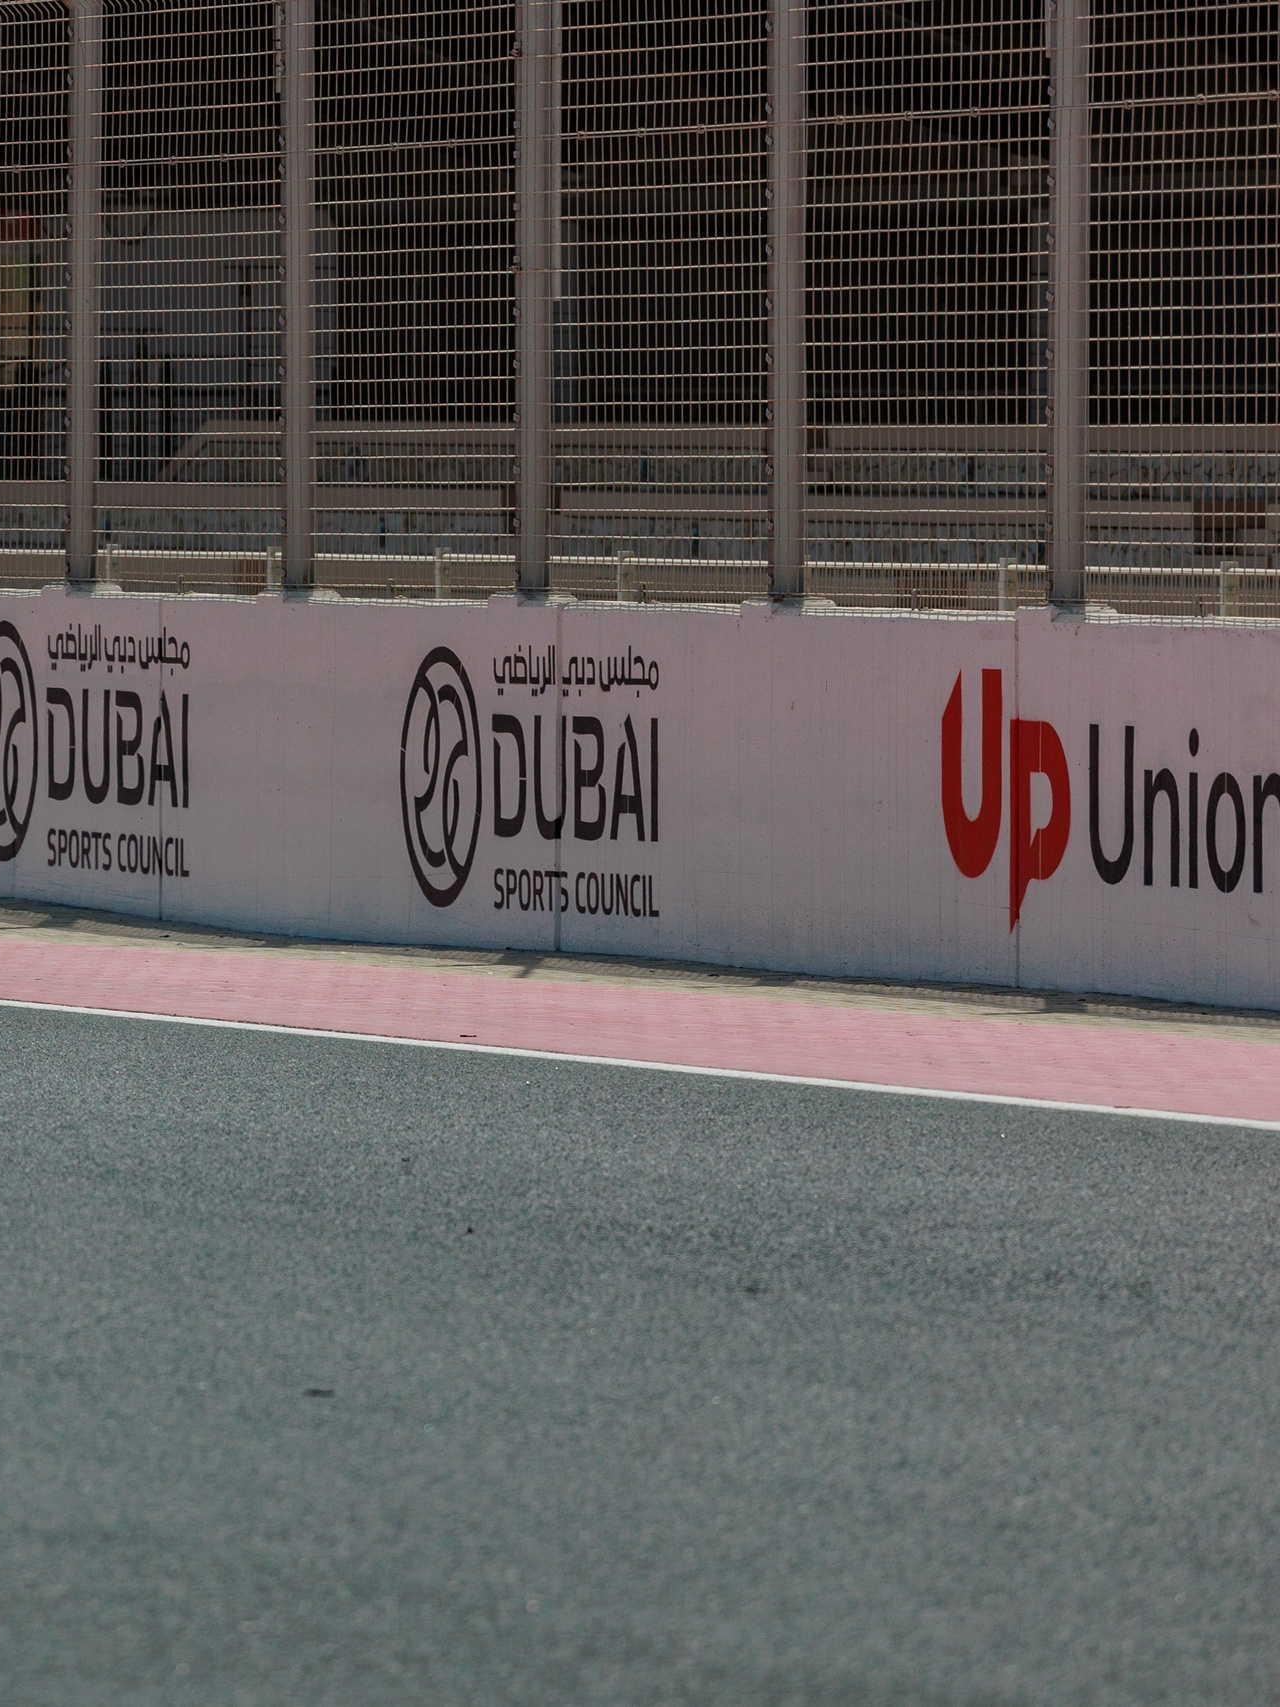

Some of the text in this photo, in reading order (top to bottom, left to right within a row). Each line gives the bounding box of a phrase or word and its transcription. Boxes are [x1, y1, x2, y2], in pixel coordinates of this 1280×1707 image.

[47, 622, 190, 676] مجلس دبي الرياضي
[493, 644, 659, 698] مجلس دبي الرياضي
[46, 687, 189, 808] DUBAI
[492, 713, 658, 842] DUBAI
[1089, 723, 1280, 893] Union
[47, 828, 189, 877] SPORTS COUNCIL
[493, 868, 660, 917] SPORTS COUNCIL
